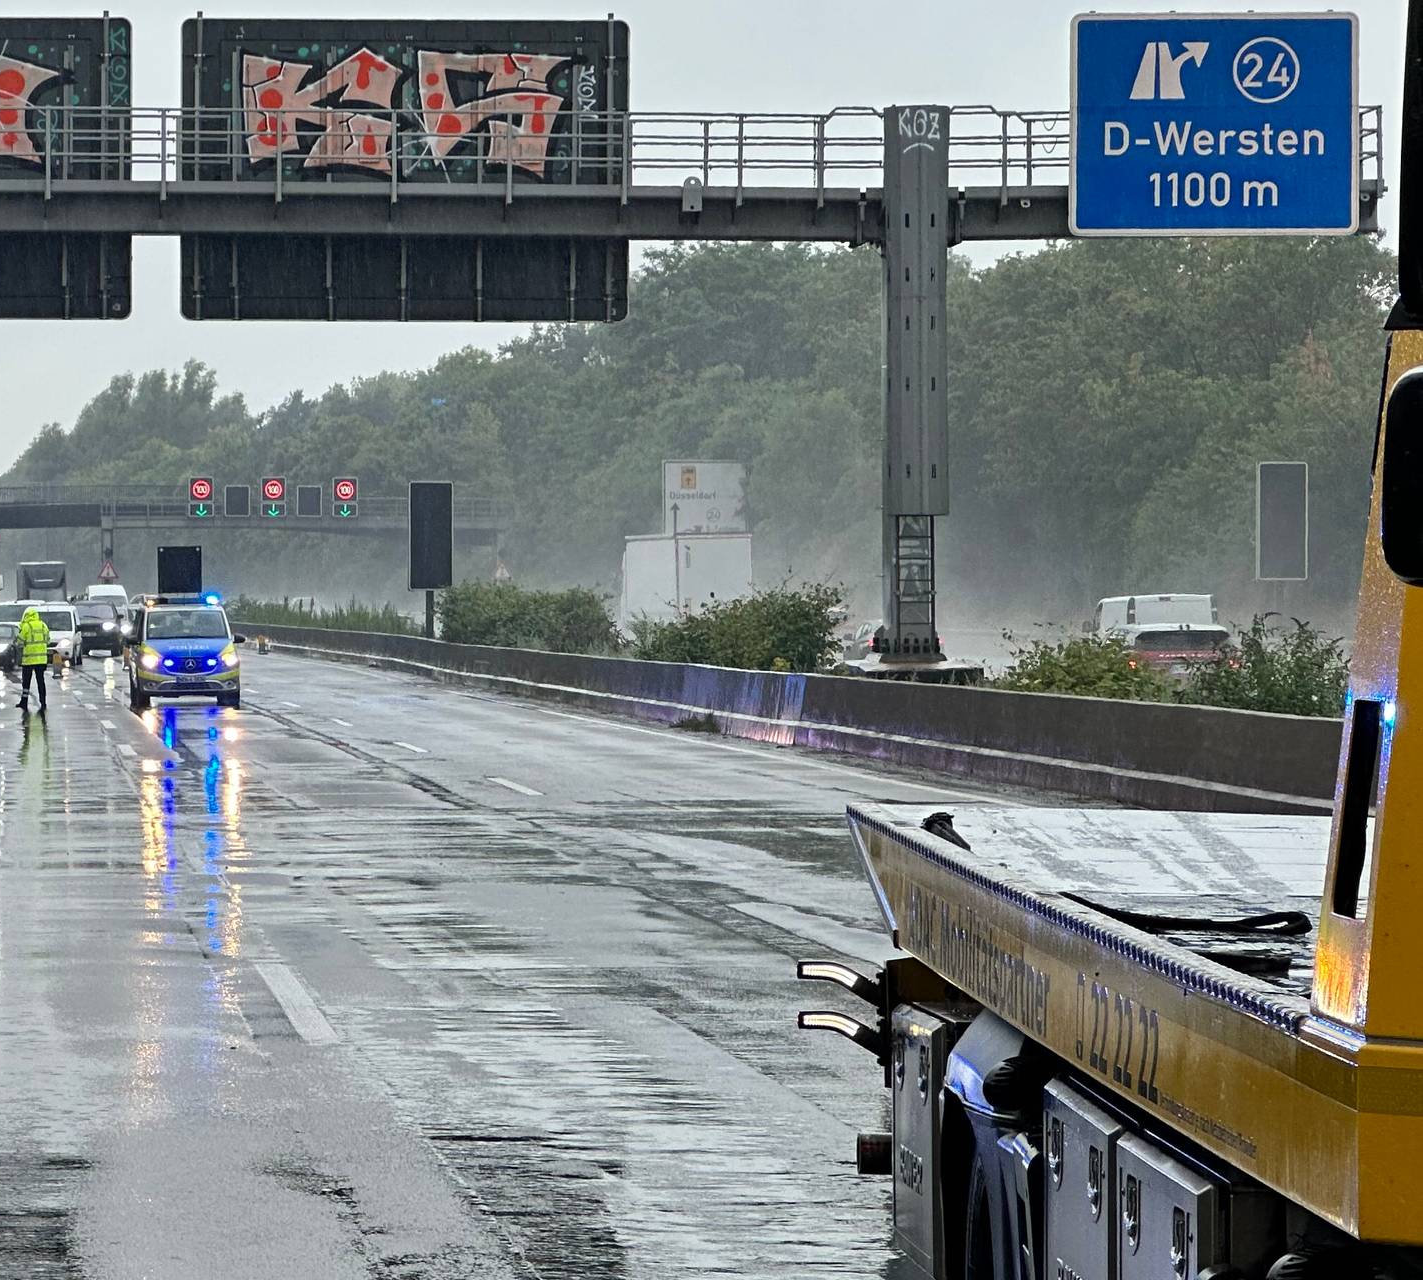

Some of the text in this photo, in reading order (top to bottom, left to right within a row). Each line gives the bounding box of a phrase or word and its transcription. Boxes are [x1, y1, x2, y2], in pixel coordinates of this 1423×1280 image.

[1242, 53, 1290, 88] 24
[1103, 121, 1325, 157] D-Wersten
[1149, 172, 1279, 207] 1100 m
[1089, 980, 1109, 1075] 22
[1113, 992, 1133, 1090] 22
[1137, 1005, 1159, 1105] 22
